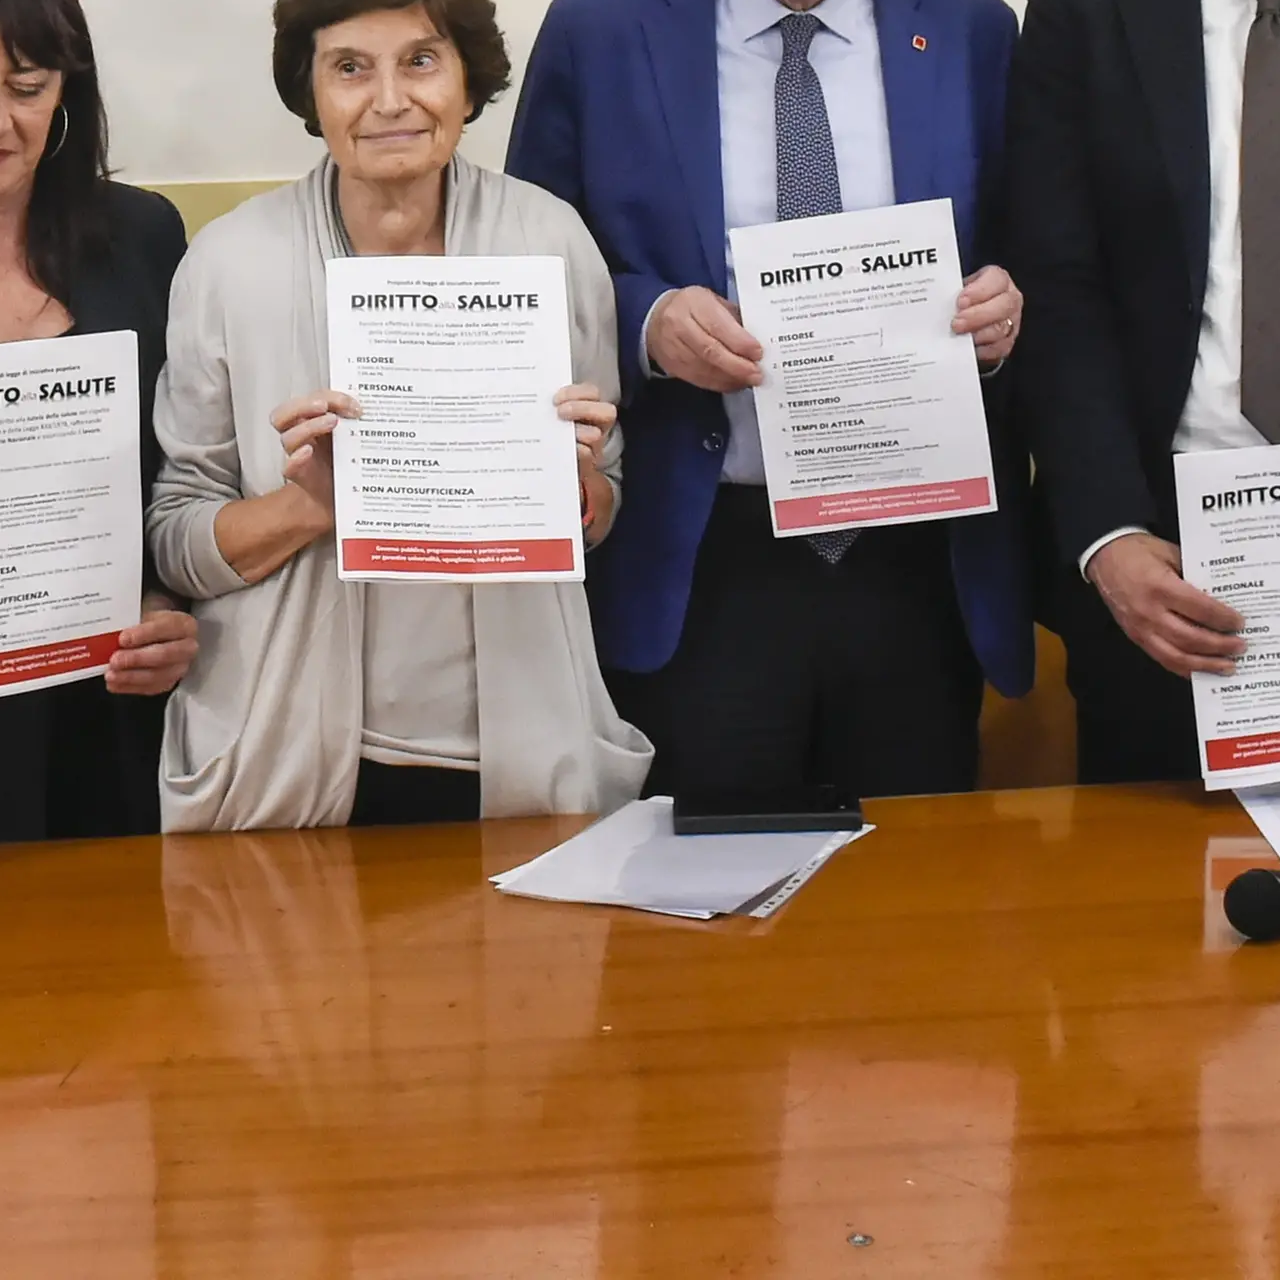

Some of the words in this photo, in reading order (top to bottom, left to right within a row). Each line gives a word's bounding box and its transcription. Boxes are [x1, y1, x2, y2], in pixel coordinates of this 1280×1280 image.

[760, 262, 843, 287] DIRITTO
[861, 248, 938, 272] SALUTE
[351, 294, 438, 309] DIRITTO
[457, 293, 539, 309] SALUTE
[778, 331, 815, 342] RISORSE
[782, 354, 834, 367] PERSONALE
[20, 391, 38, 401] alla
[39, 376, 116, 400] SALUTE
[358, 383, 413, 391] PERSONALE
[787, 396, 841, 407] TERRITORIO
[830, 418, 865, 428] ATTESA
[359, 429, 417, 438] TERRITORIO
[816, 439, 900, 453] AUTOSUFFICIENZA
[386, 486, 475, 495] AUTOSUFFICIENZA
[1208, 555, 1245, 565] RISORSE
[1211, 580, 1264, 593] PERSONALE
